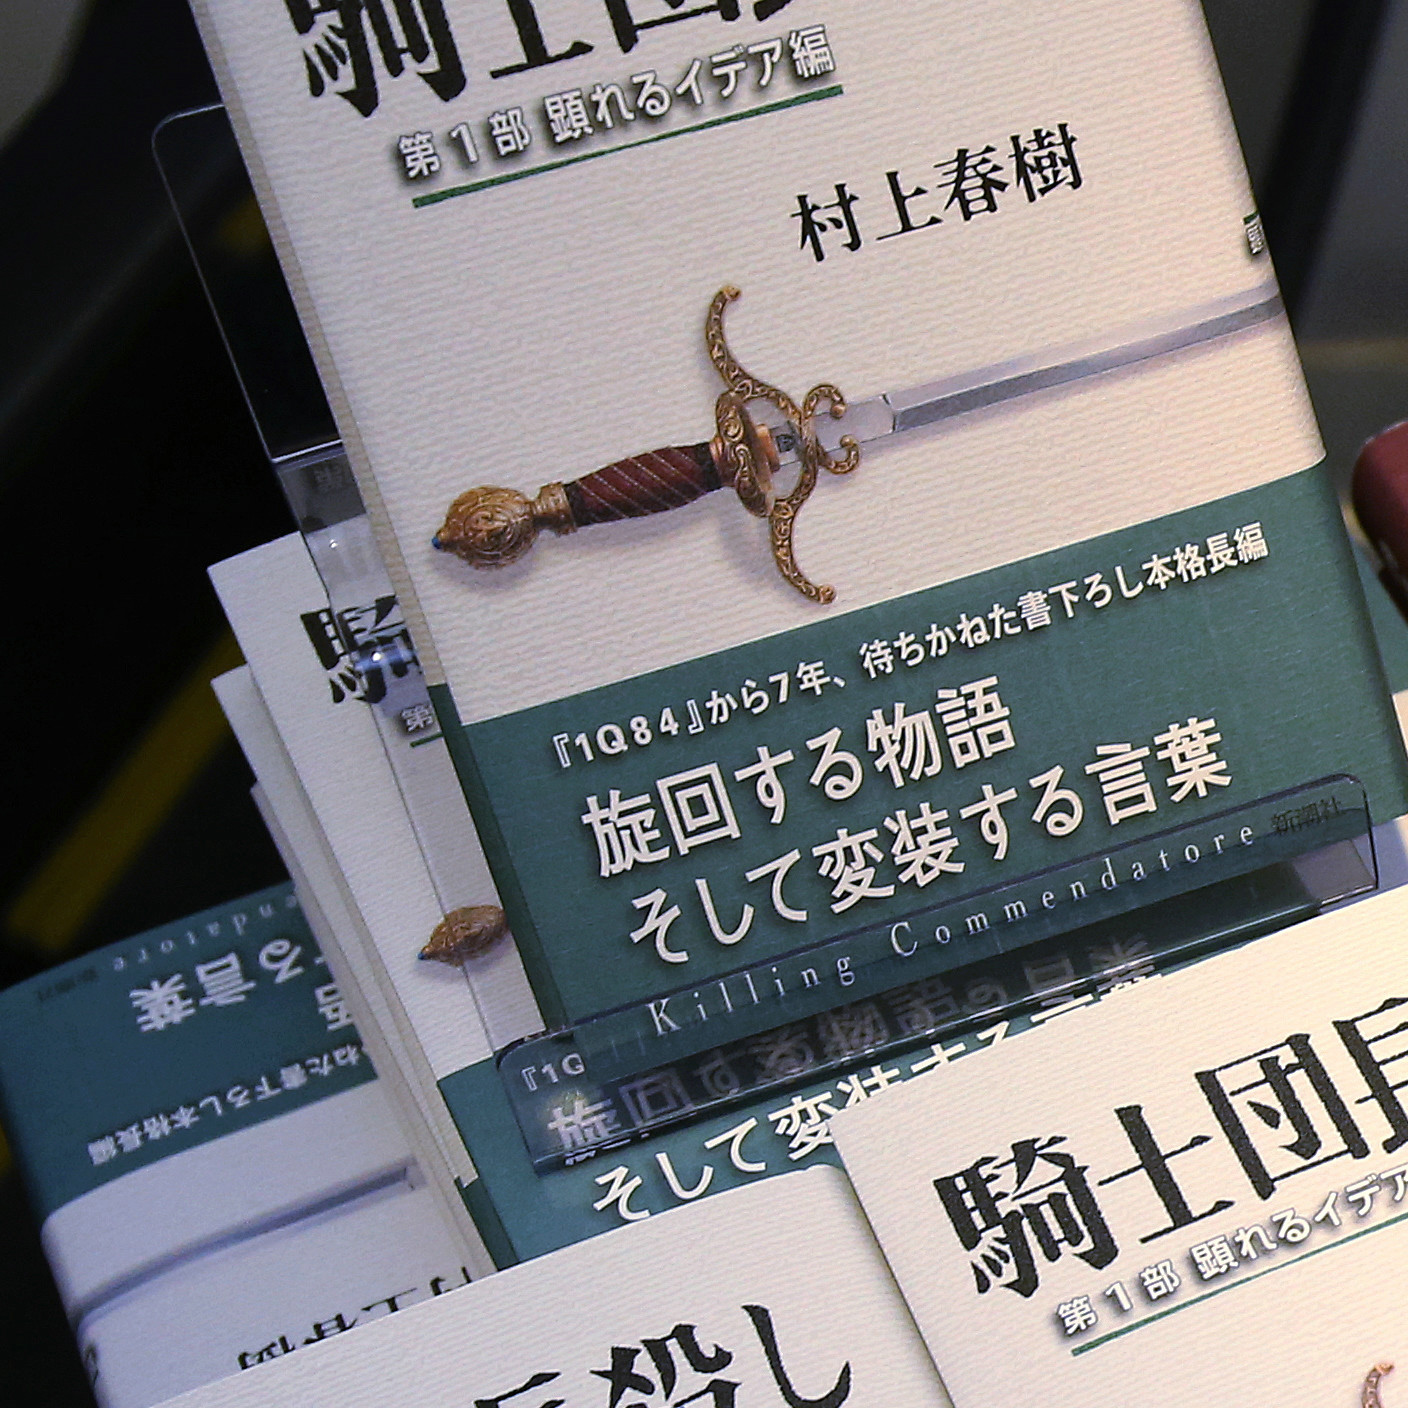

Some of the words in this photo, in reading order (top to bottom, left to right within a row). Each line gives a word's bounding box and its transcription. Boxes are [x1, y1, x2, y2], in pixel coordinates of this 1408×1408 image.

[398, 108, 532, 177] 第1部
[546, 24, 836, 143] 顕れるイデア編
[791, 123, 1086, 262] 村上春樹
[580, 675, 1015, 880] 旋回する物語
[627, 716, 1234, 966] そして変装する言葉
[129, 938, 325, 1032] る言葉
[646, 955, 856, 1038] Killing
[889, 824, 1256, 961] Commendatore
[87, 1042, 370, 1166] ねた書下ろし本格長編
[1056, 1260, 1181, 1338] 第1部
